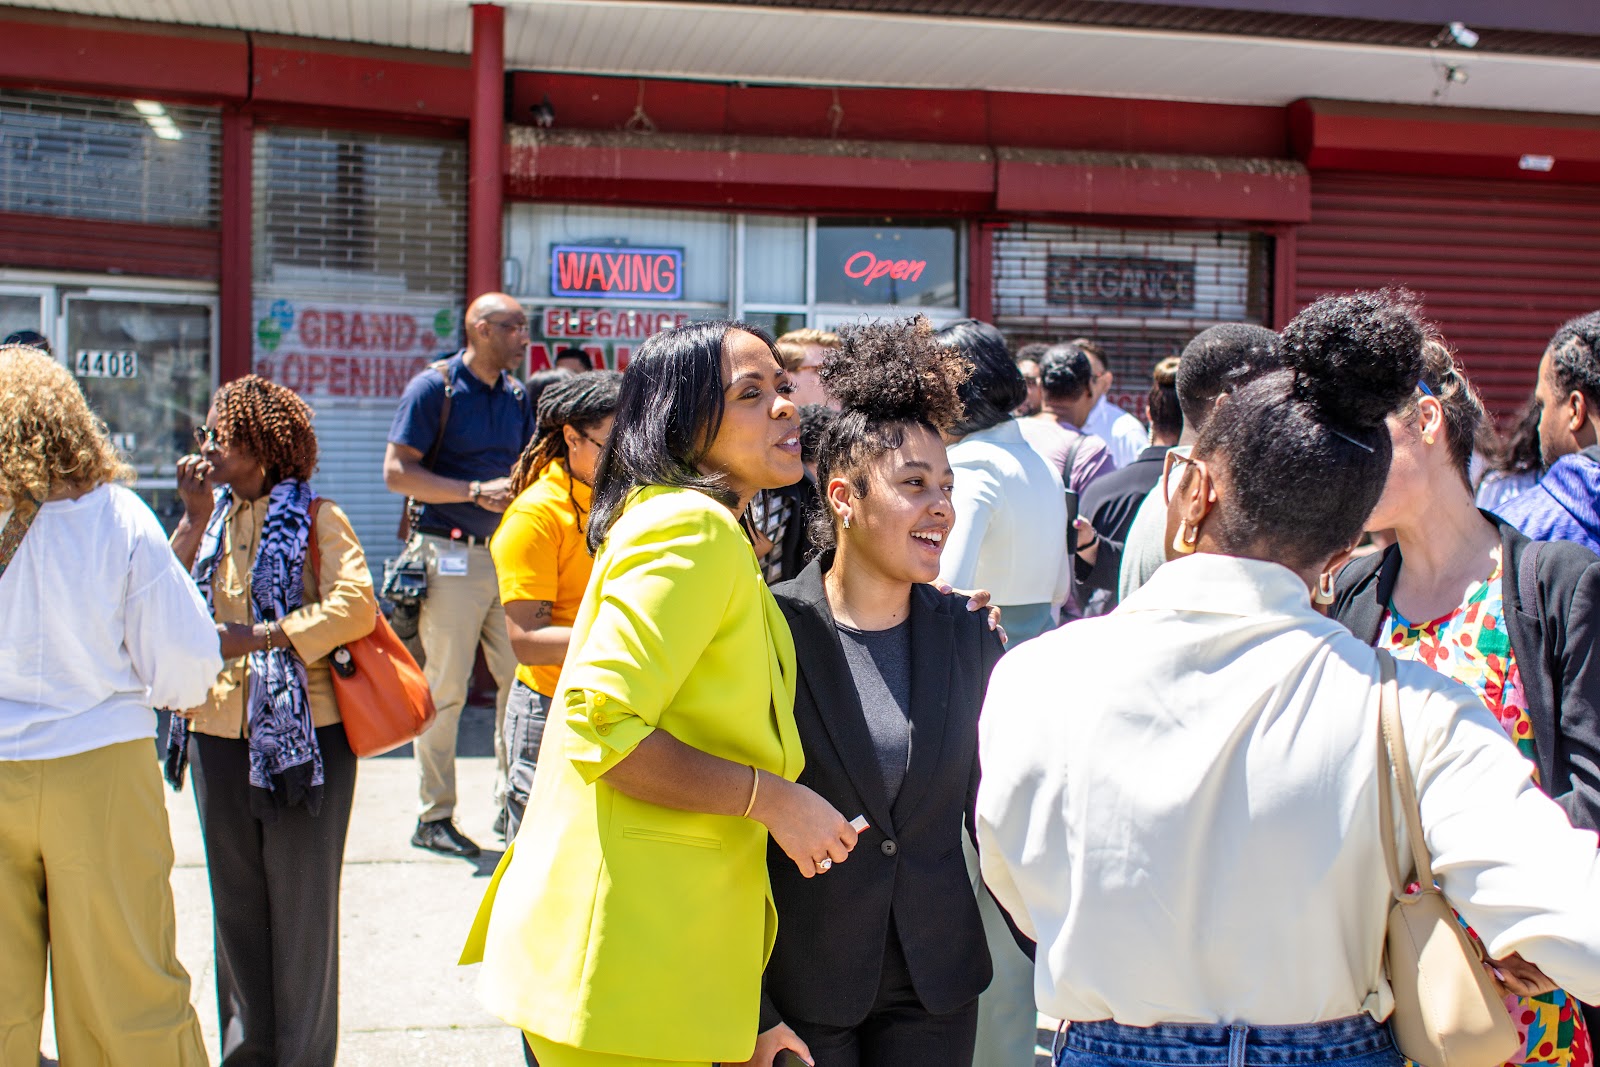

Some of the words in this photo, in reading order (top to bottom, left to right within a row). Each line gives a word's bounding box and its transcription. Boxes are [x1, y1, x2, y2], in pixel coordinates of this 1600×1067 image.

[557, 251, 676, 293] WAXING
[844, 250, 927, 287] Open
[299, 309, 416, 351] GRAND
[79, 352, 134, 376] 4408
